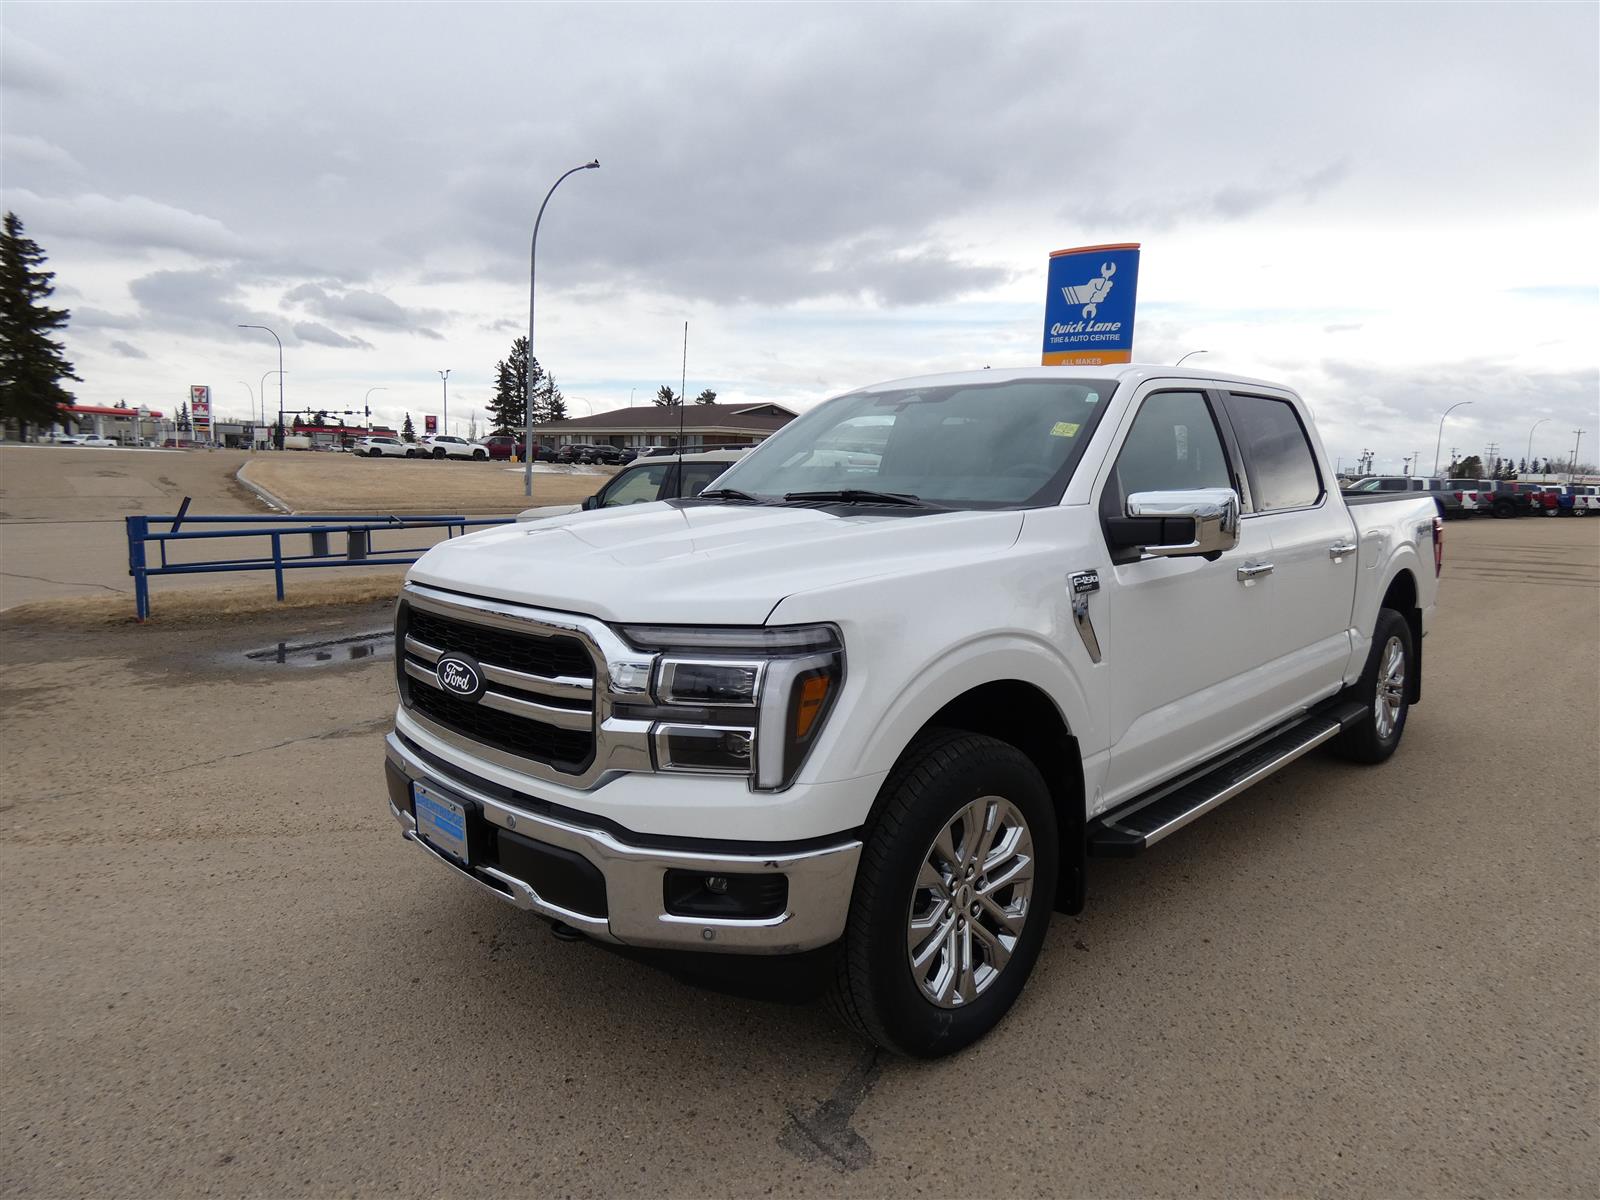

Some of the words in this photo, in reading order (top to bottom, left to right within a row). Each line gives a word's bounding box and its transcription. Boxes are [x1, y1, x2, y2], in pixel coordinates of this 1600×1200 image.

[1051, 321, 1085, 336] Quick
[1085, 320, 1121, 332] Lane
[1050, 336, 1064, 344] TIRE
[444, 662, 470, 690] Ford
